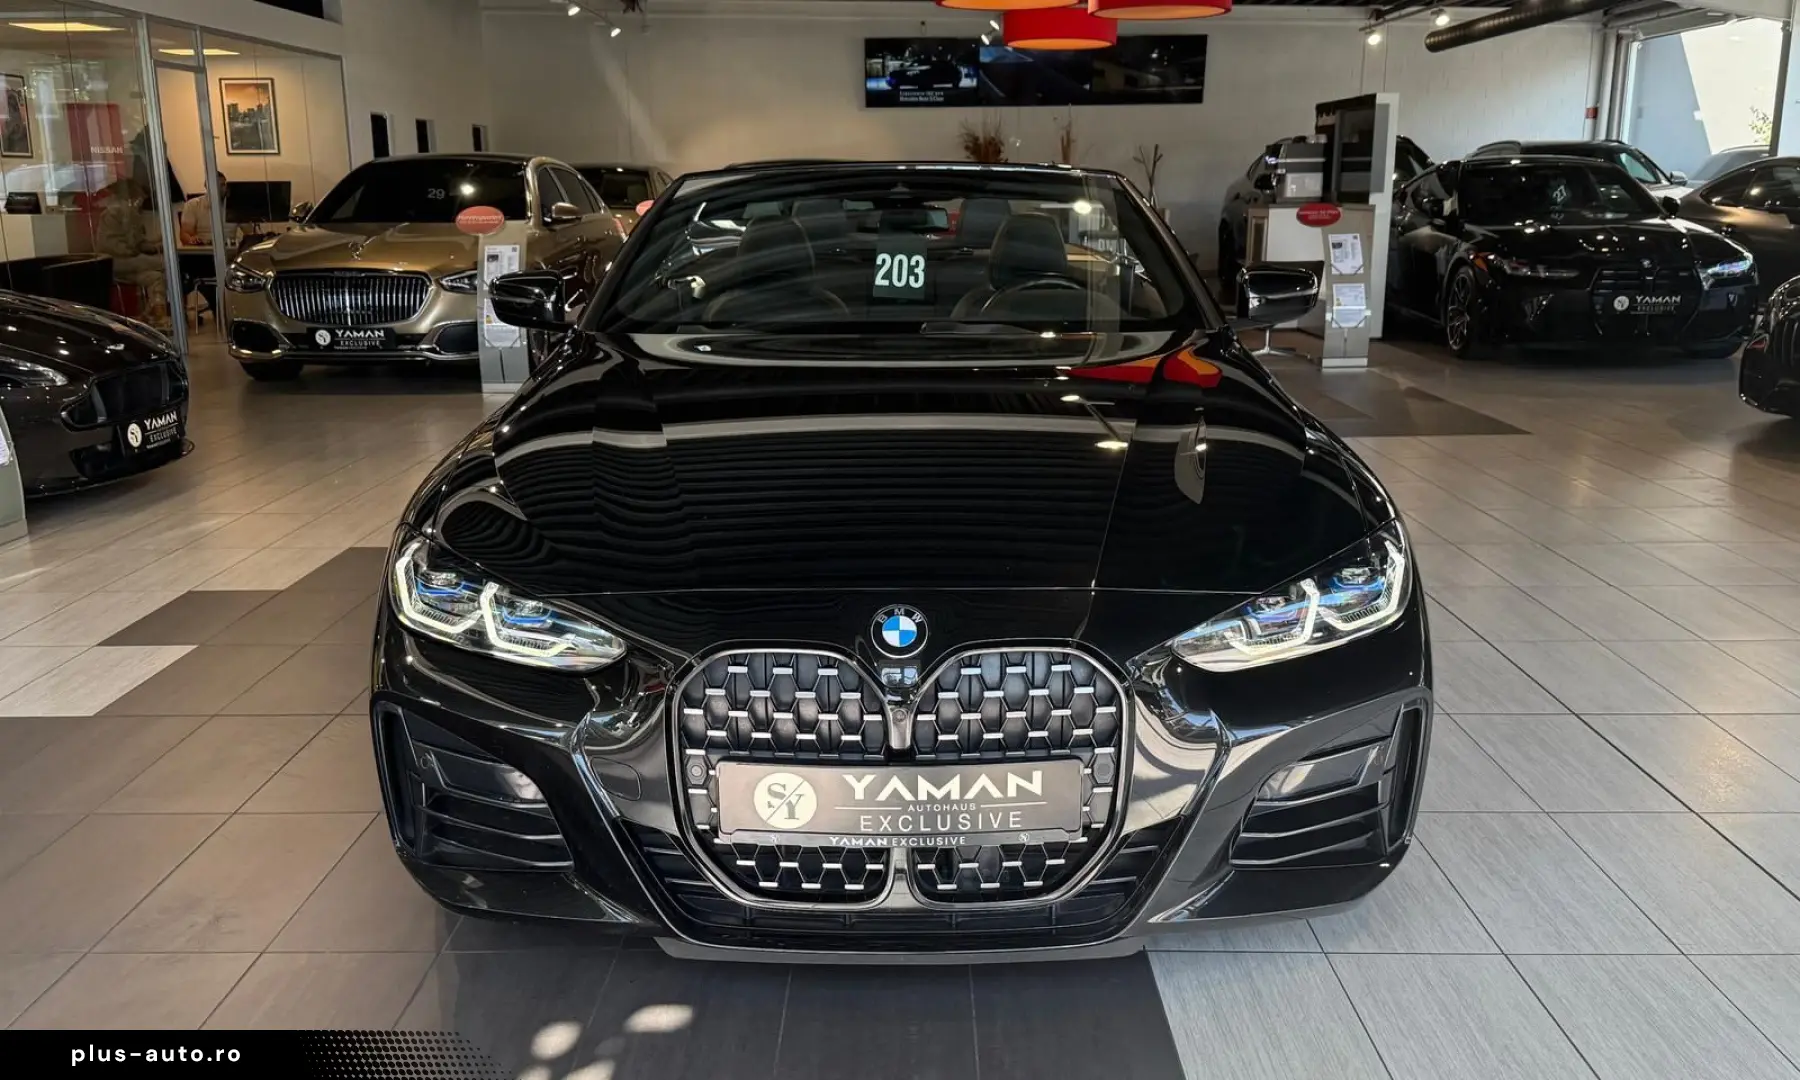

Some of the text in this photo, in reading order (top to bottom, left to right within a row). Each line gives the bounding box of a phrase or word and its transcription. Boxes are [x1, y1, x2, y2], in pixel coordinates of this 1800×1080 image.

[91, 146, 123, 154] NISSAN
[875, 253, 925, 288] 203
[1635, 295, 1681, 303] YAMAN
[335, 329, 384, 338] YAMAN
[144, 410, 178, 430] YAMAN
[876, 608, 923, 623] BMW
[842, 770, 1043, 801] YAMAN
[907, 803, 977, 812] AUTOHAUS
[860, 811, 1022, 832] EXCLUSIVE
[829, 836, 966, 846] YAMAN EXCLUSIVE
